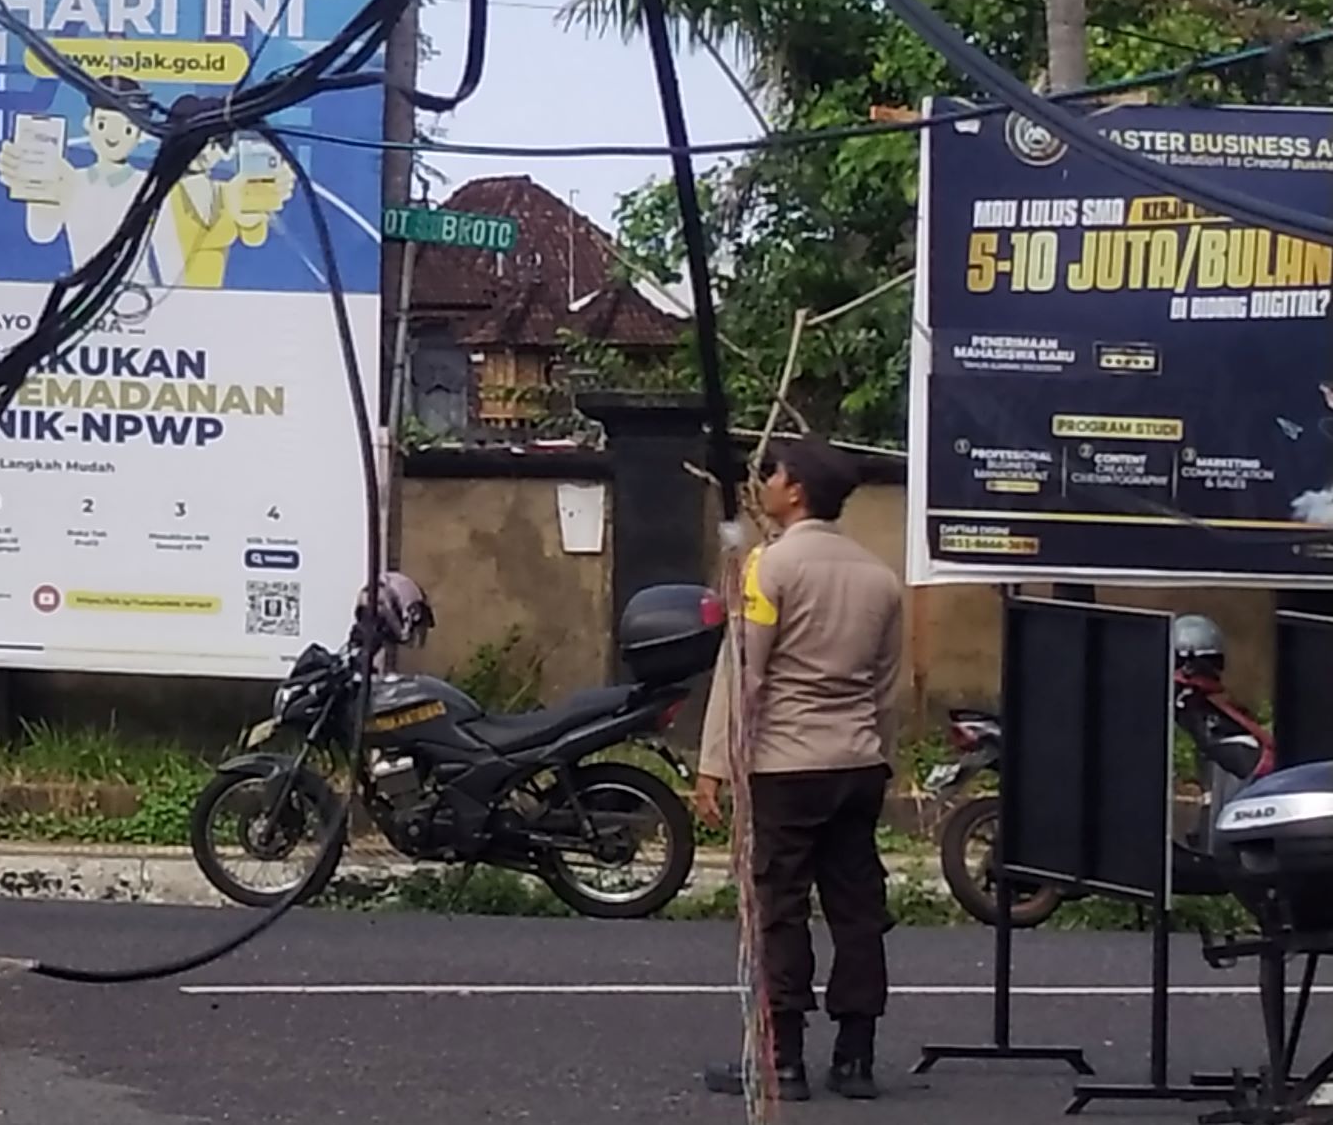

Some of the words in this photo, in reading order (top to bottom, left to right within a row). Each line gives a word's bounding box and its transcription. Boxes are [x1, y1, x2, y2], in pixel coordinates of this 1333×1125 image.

[64, 51, 226, 74] ww.pajak.go.id
[1098, 129, 1185, 152] ASTER
[1190, 133, 1311, 157] BUSINESS
[1316, 138, 1333, 158] A
[1021, 198, 1079, 227] LULUS
[967, 232, 1058, 292] 5-10
[1067, 225, 1332, 293] JUTA/BULAN
[1251, 289, 1331, 318] DIGITAL?
[17, 376, 284, 416] EMADANAN
[1055, 418, 1133, 435] PROGRAM
[1135, 421, 1180, 436] STUDI
[0, 458, 62, 473] Langkah
[66, 460, 116, 474] Mudah
[82, 498, 94, 513] 2
[174, 501, 187, 517] 3
[266, 505, 281, 520] 4
